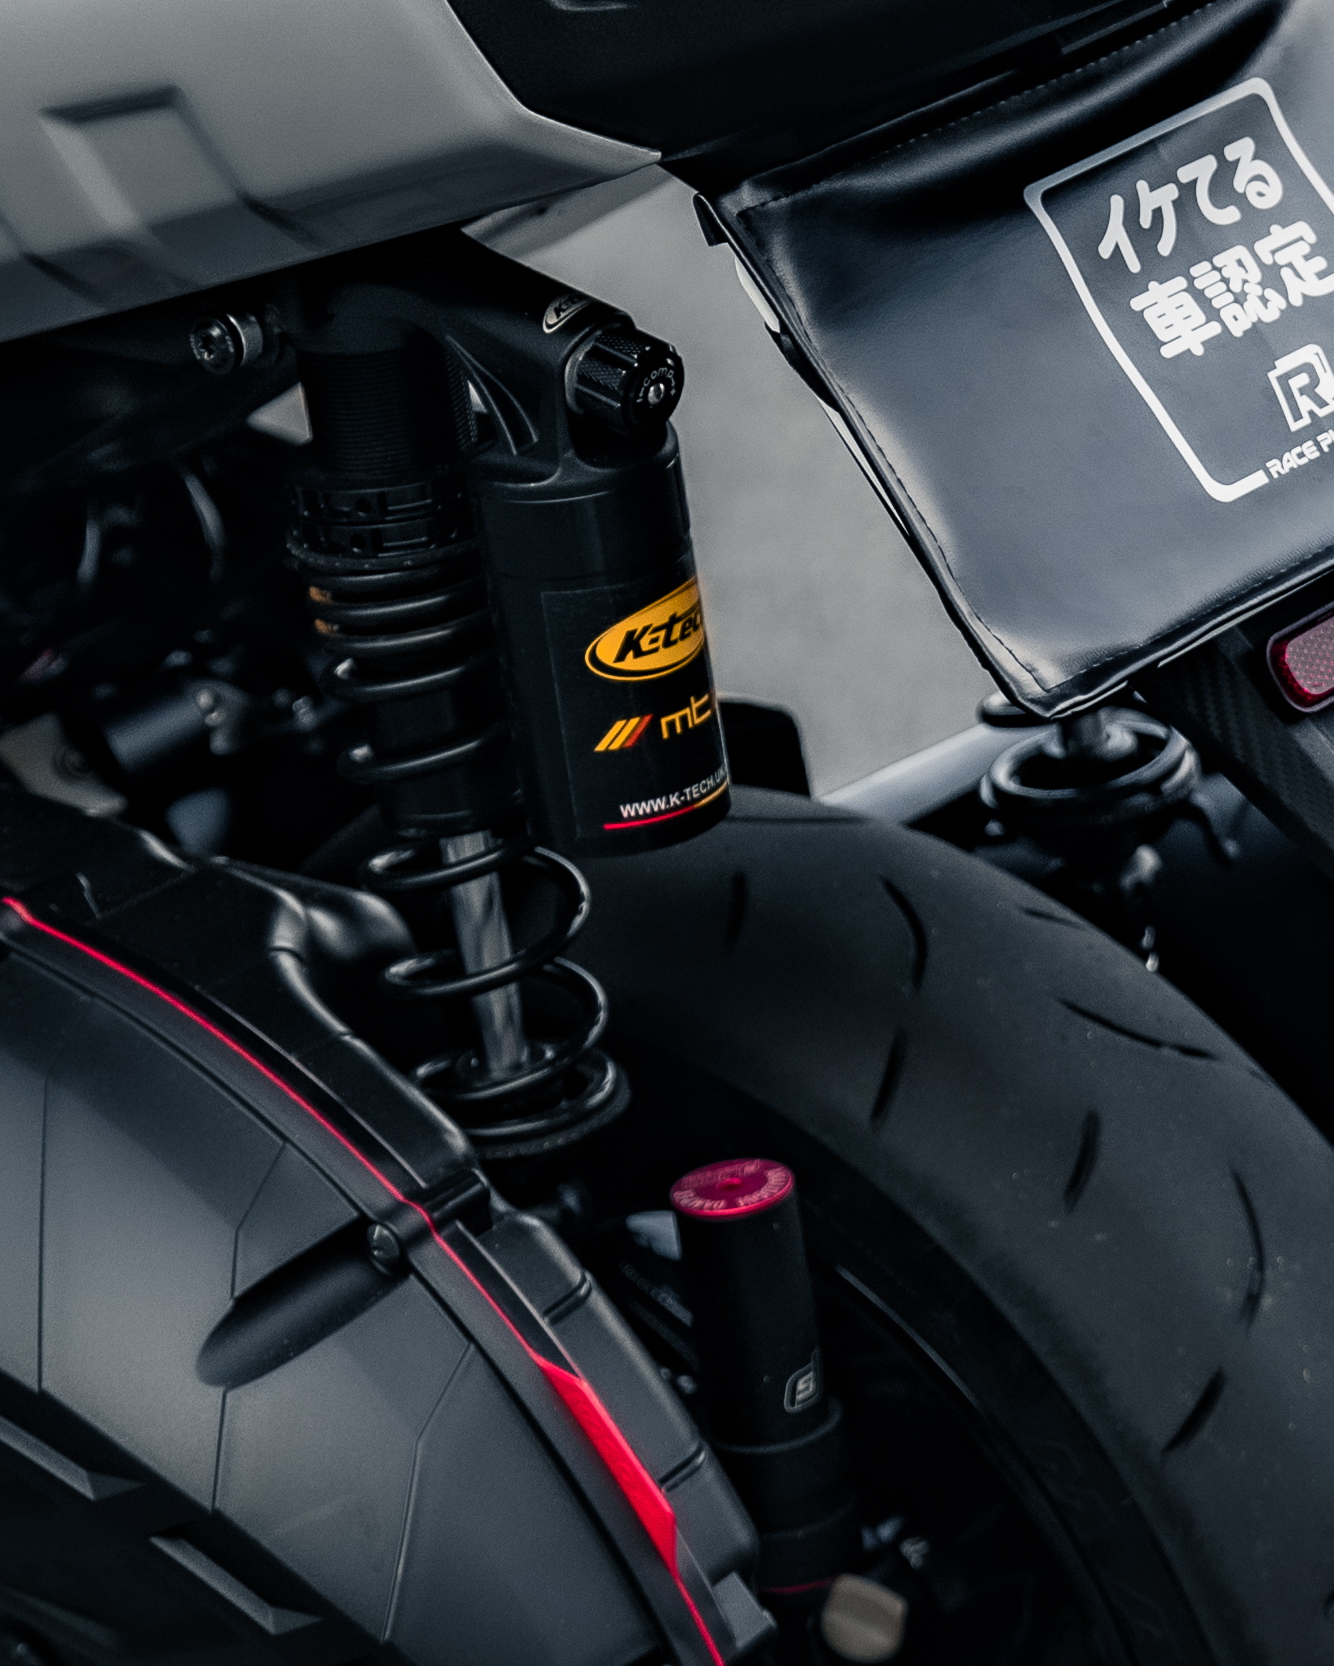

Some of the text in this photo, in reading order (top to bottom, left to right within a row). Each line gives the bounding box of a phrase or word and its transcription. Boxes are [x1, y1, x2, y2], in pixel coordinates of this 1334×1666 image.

[1097, 136, 1284, 274] イケてる
[1266, 439, 1321, 479] RACE
[660, 693, 714, 740] mt
